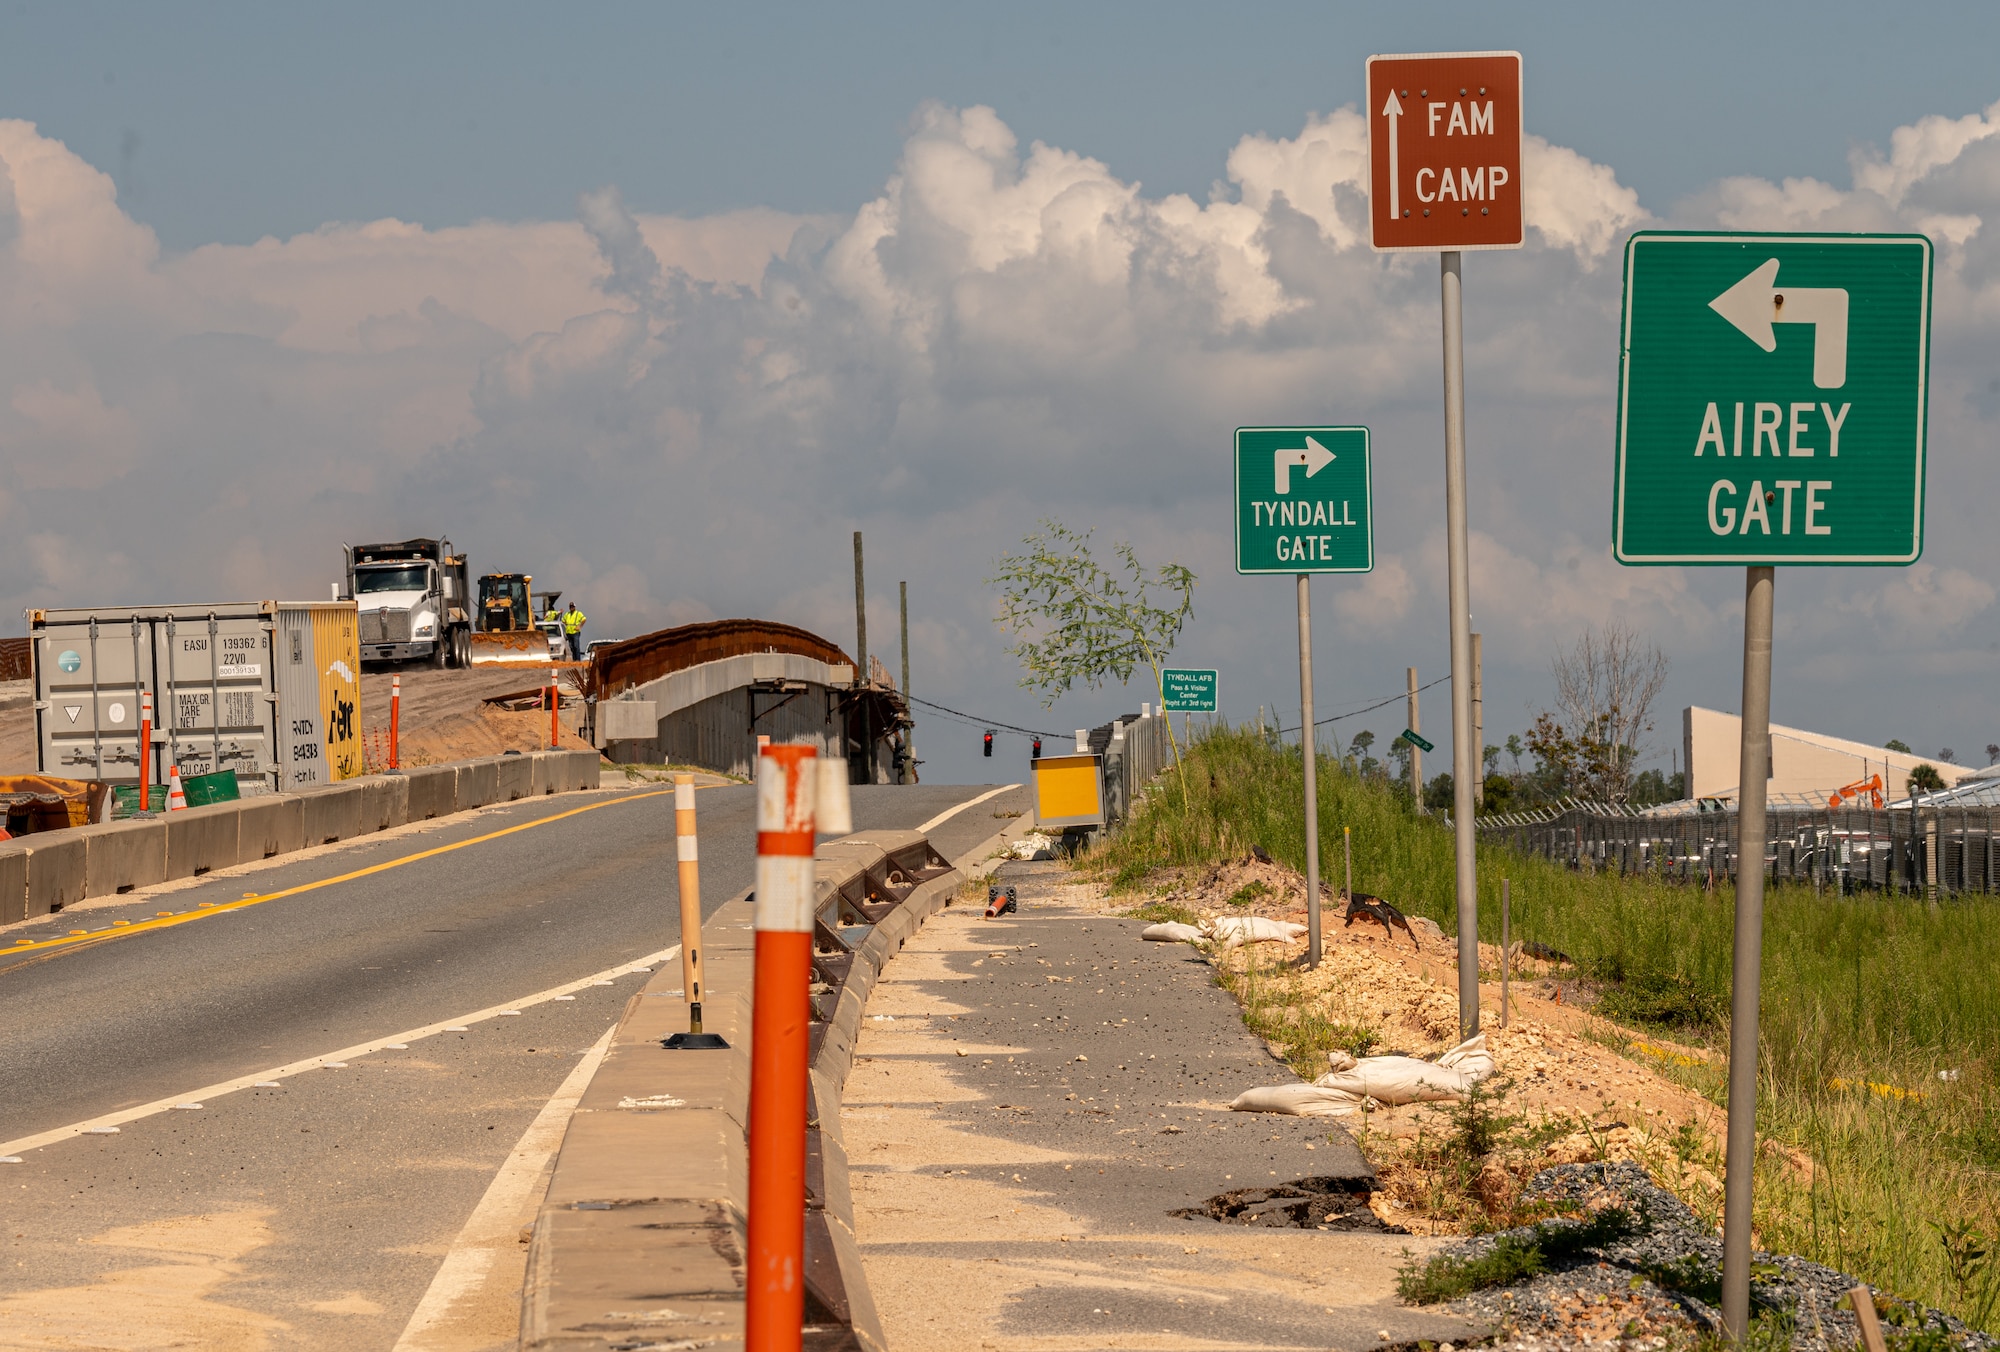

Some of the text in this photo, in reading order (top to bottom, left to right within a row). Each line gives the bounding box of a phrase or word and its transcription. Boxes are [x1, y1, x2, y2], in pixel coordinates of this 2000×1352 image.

[1428, 101, 1494, 136] FAM
[1415, 166, 1509, 203] CAMP
[1694, 402, 1851, 457] AIREY
[1251, 501, 1356, 526] TYNDALL
[1708, 479, 1832, 536] GATE
[1276, 535, 1333, 561] GATE
[184, 637, 268, 651] EASU 139362 6
[1167, 673, 1213, 682] TYNDALL AFB
[1190, 684, 1208, 692] Visitor
[180, 705, 201, 717] TARE
[181, 716, 196, 728] NET
[180, 763, 211, 776] CU.CAP
